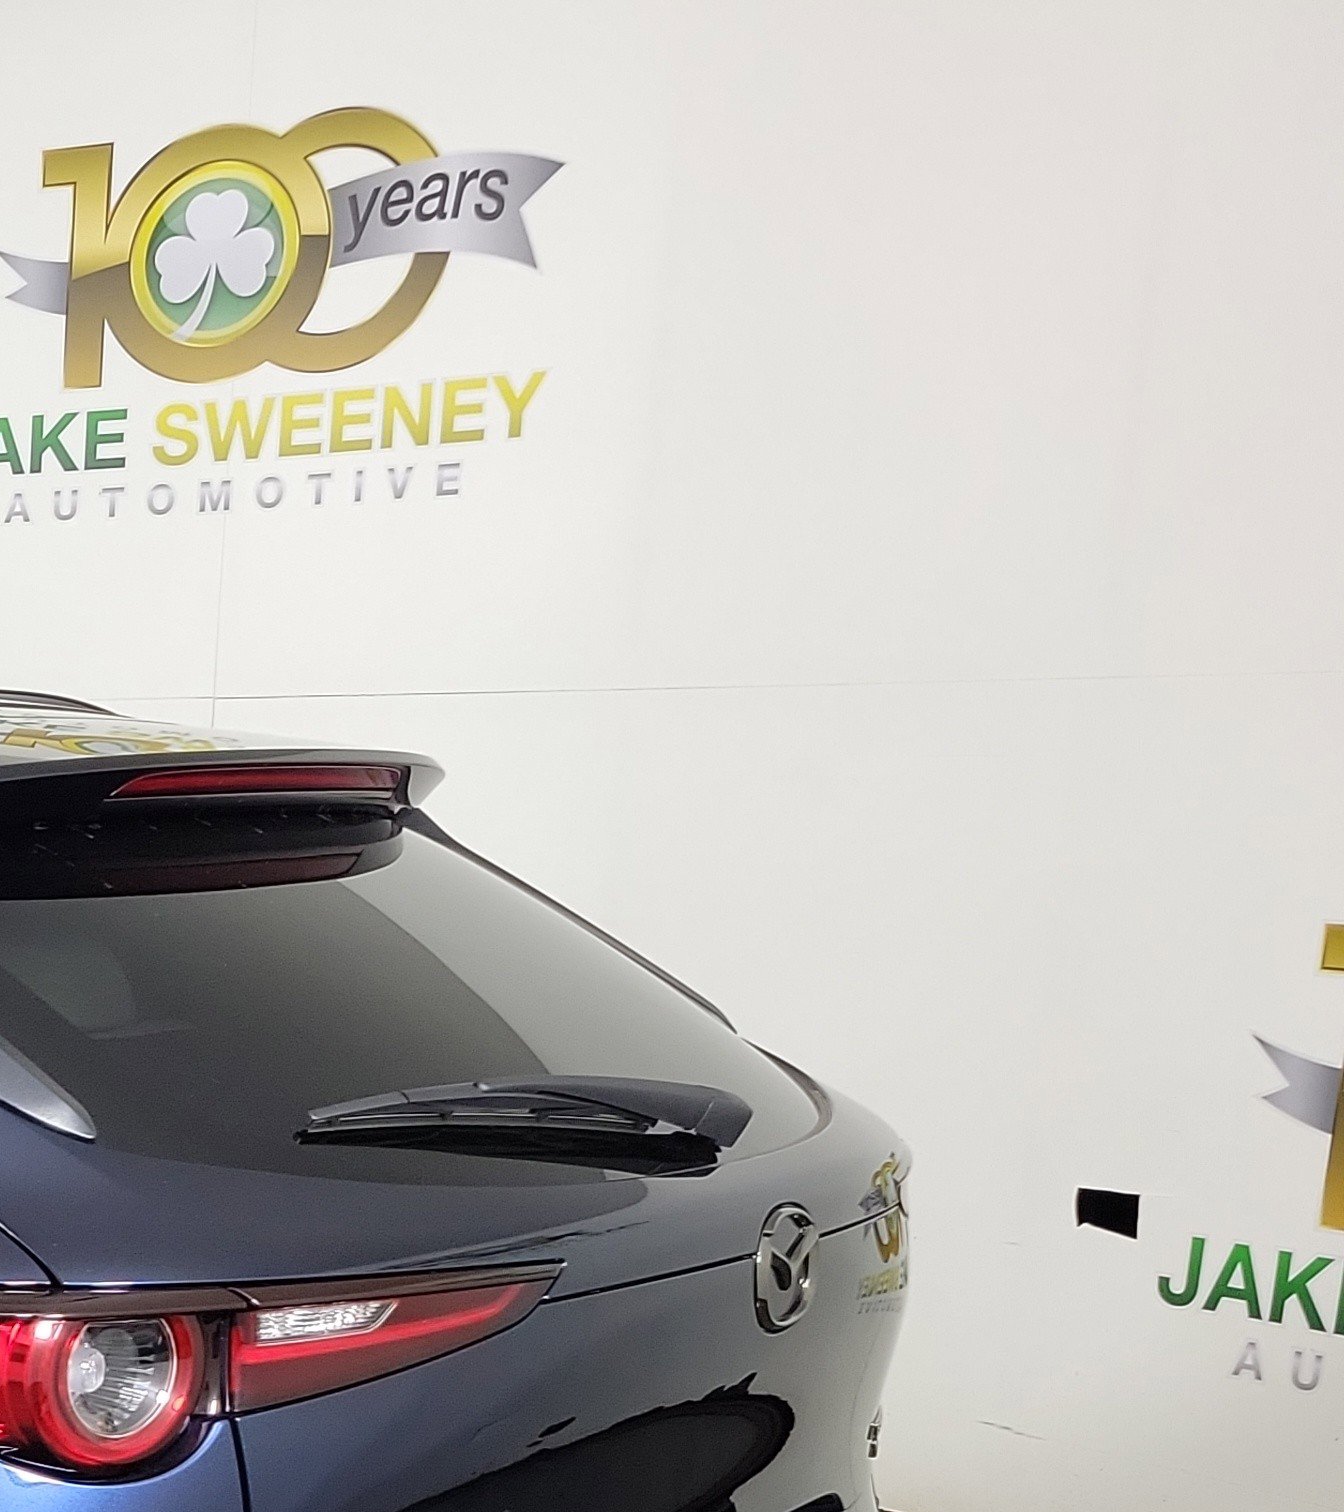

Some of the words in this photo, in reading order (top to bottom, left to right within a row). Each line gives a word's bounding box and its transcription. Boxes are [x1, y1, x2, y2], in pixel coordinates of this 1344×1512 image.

[42, 105, 452, 390] 100
[341, 168, 510, 253] years
[152, 370, 548, 467] SWEENEY
[3, 461, 463, 524] AUTOMOTIVE
[1157, 1236, 1344, 1336] JAK
